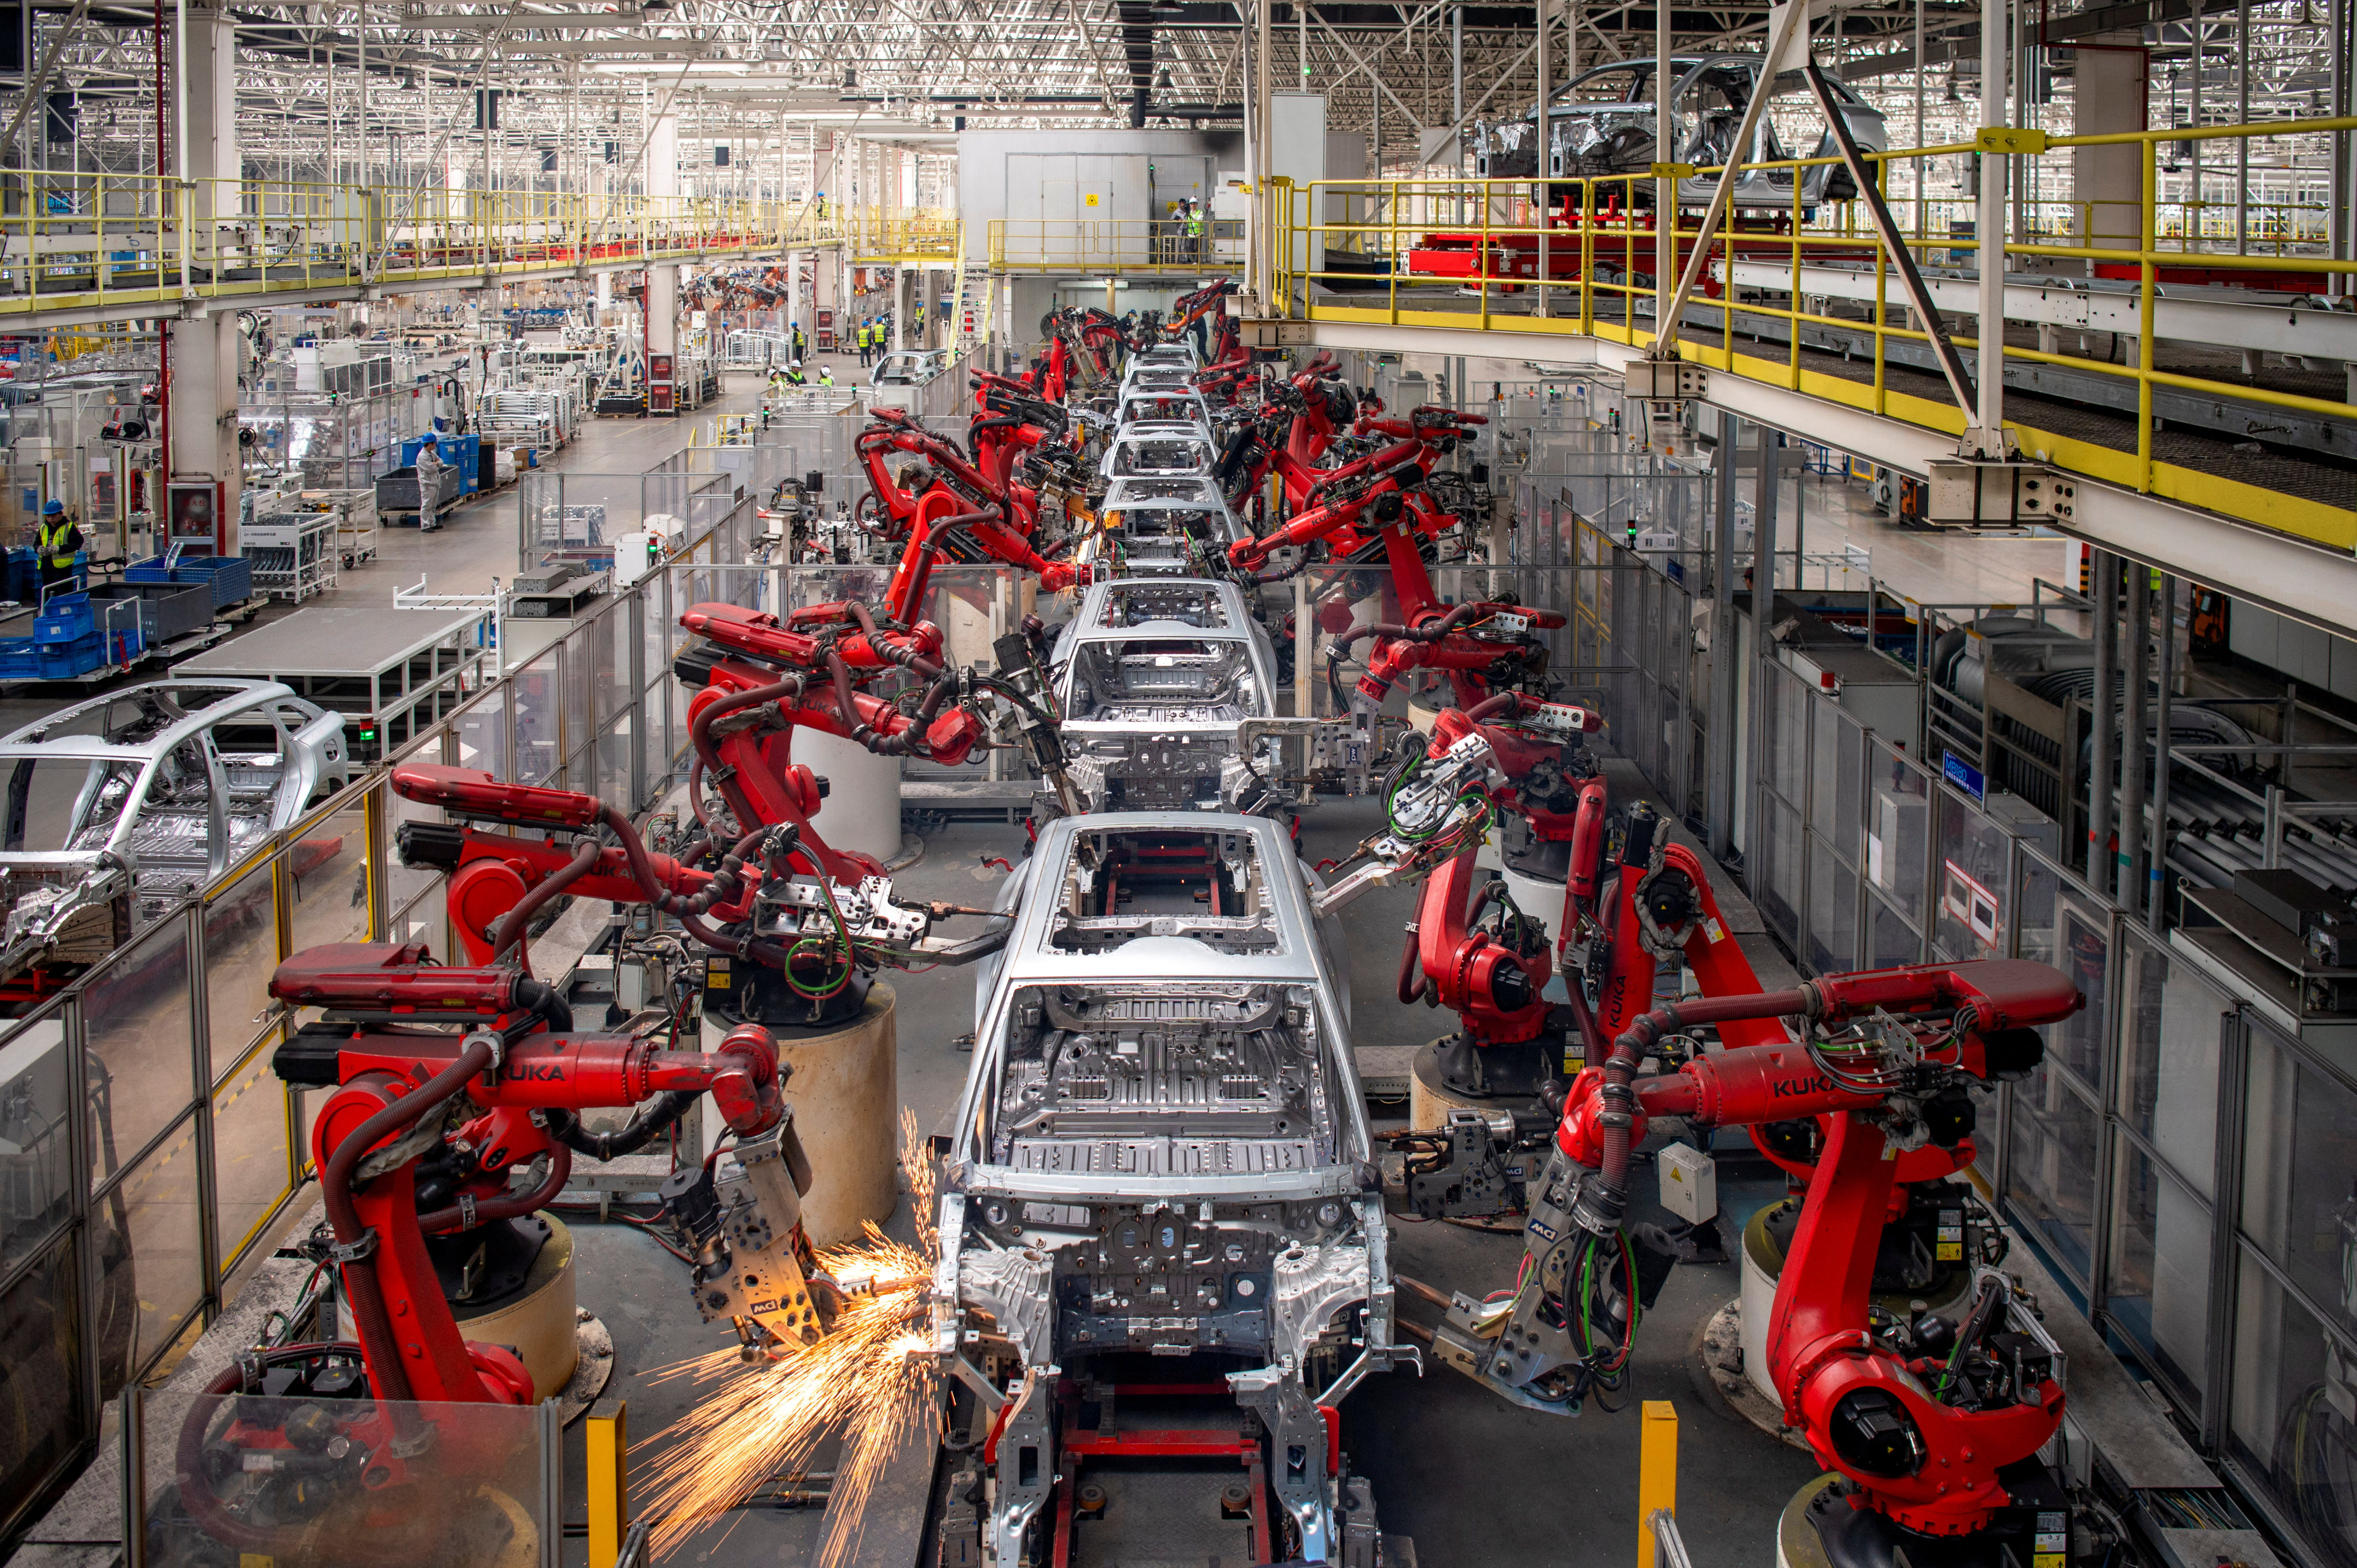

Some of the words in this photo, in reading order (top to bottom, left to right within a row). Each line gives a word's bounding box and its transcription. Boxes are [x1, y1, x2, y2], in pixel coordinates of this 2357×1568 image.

[1220, 450, 1230, 464] KUKA
[224, 468, 234, 477] D12
[1311, 509, 1342, 526] KUKA
[950, 545, 966, 559] KUKA
[1370, 550, 1386, 562] KUKA
[1458, 645, 1482, 653] KUKA
[1946, 758, 1967, 781] MB180
[591, 863, 637, 882] UKA
[1609, 975, 1627, 1028] KUKA
